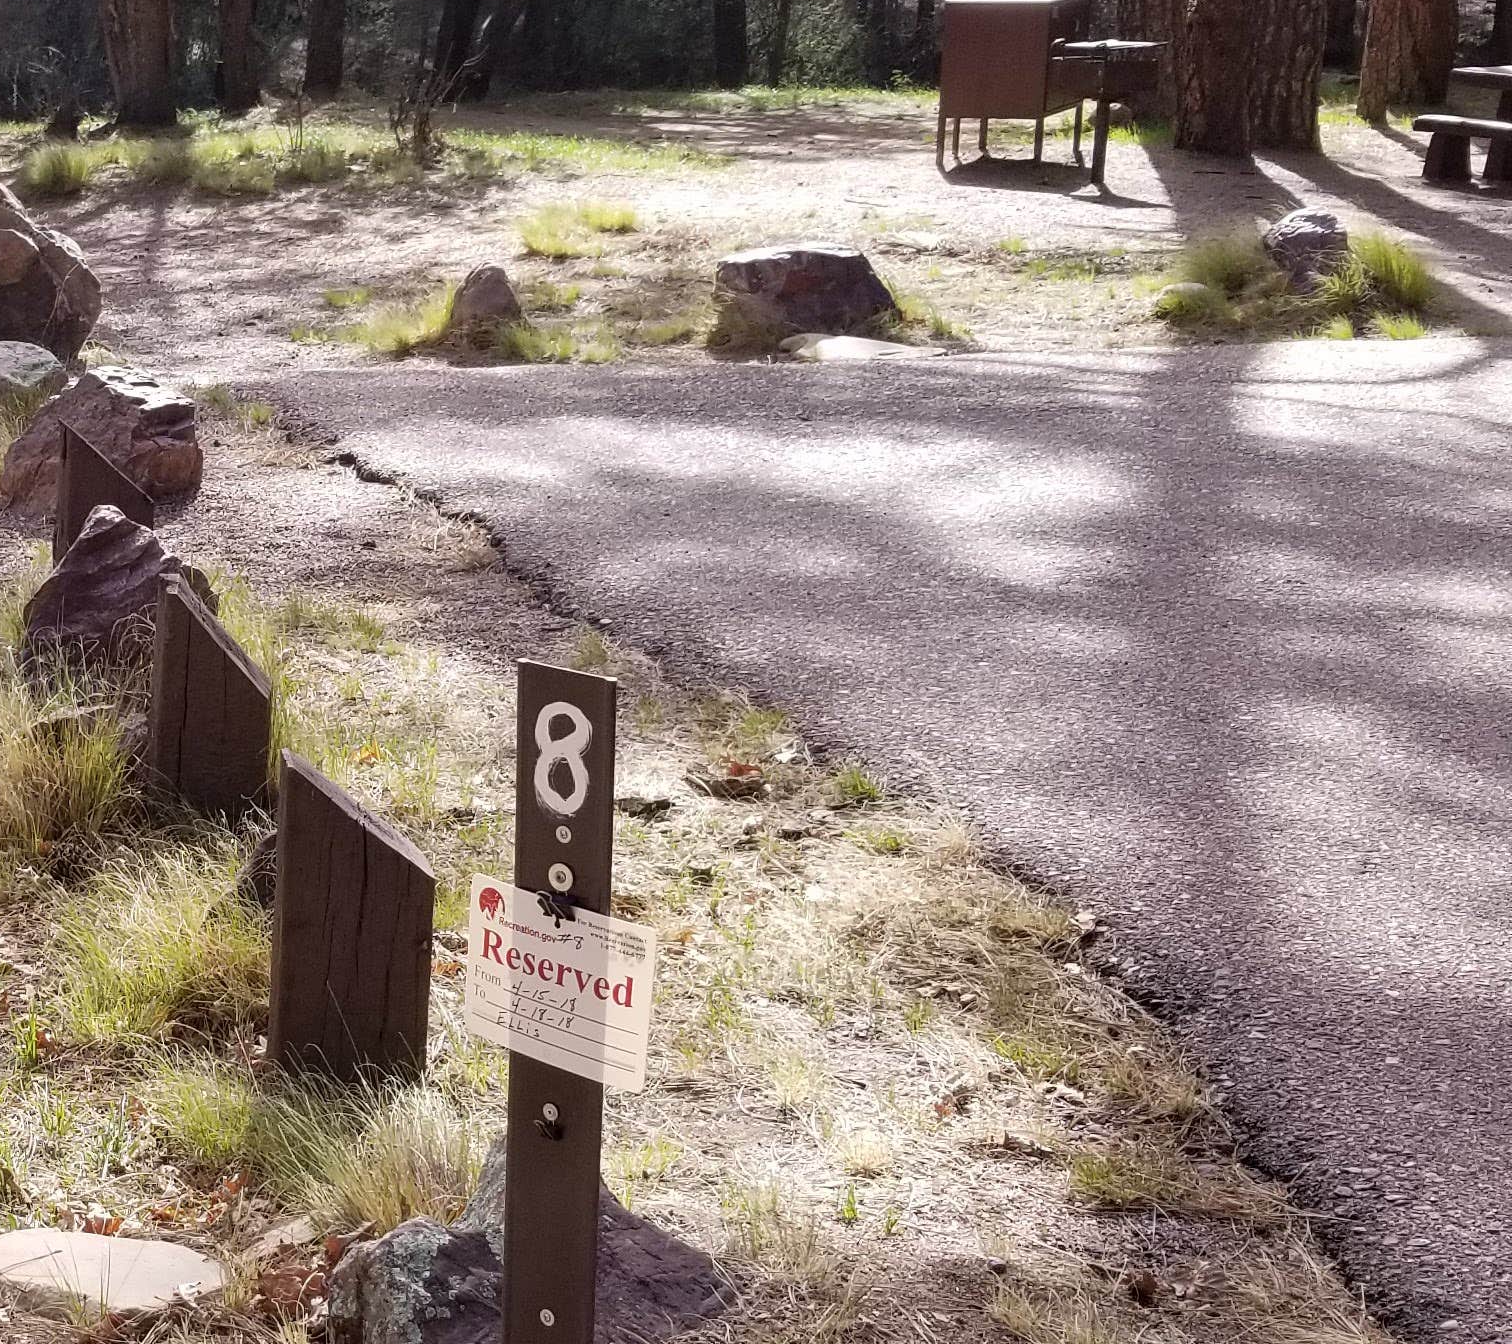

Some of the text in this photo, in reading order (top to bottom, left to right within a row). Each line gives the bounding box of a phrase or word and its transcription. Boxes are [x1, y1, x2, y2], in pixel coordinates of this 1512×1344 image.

[534, 701, 592, 816] 8
[499, 917, 556, 944] Recreation.gov
[474, 964, 501, 986] From
[480, 927, 633, 1008] Reserved
[473, 983, 486, 998] To
[512, 981, 577, 1012] 4-15-18
